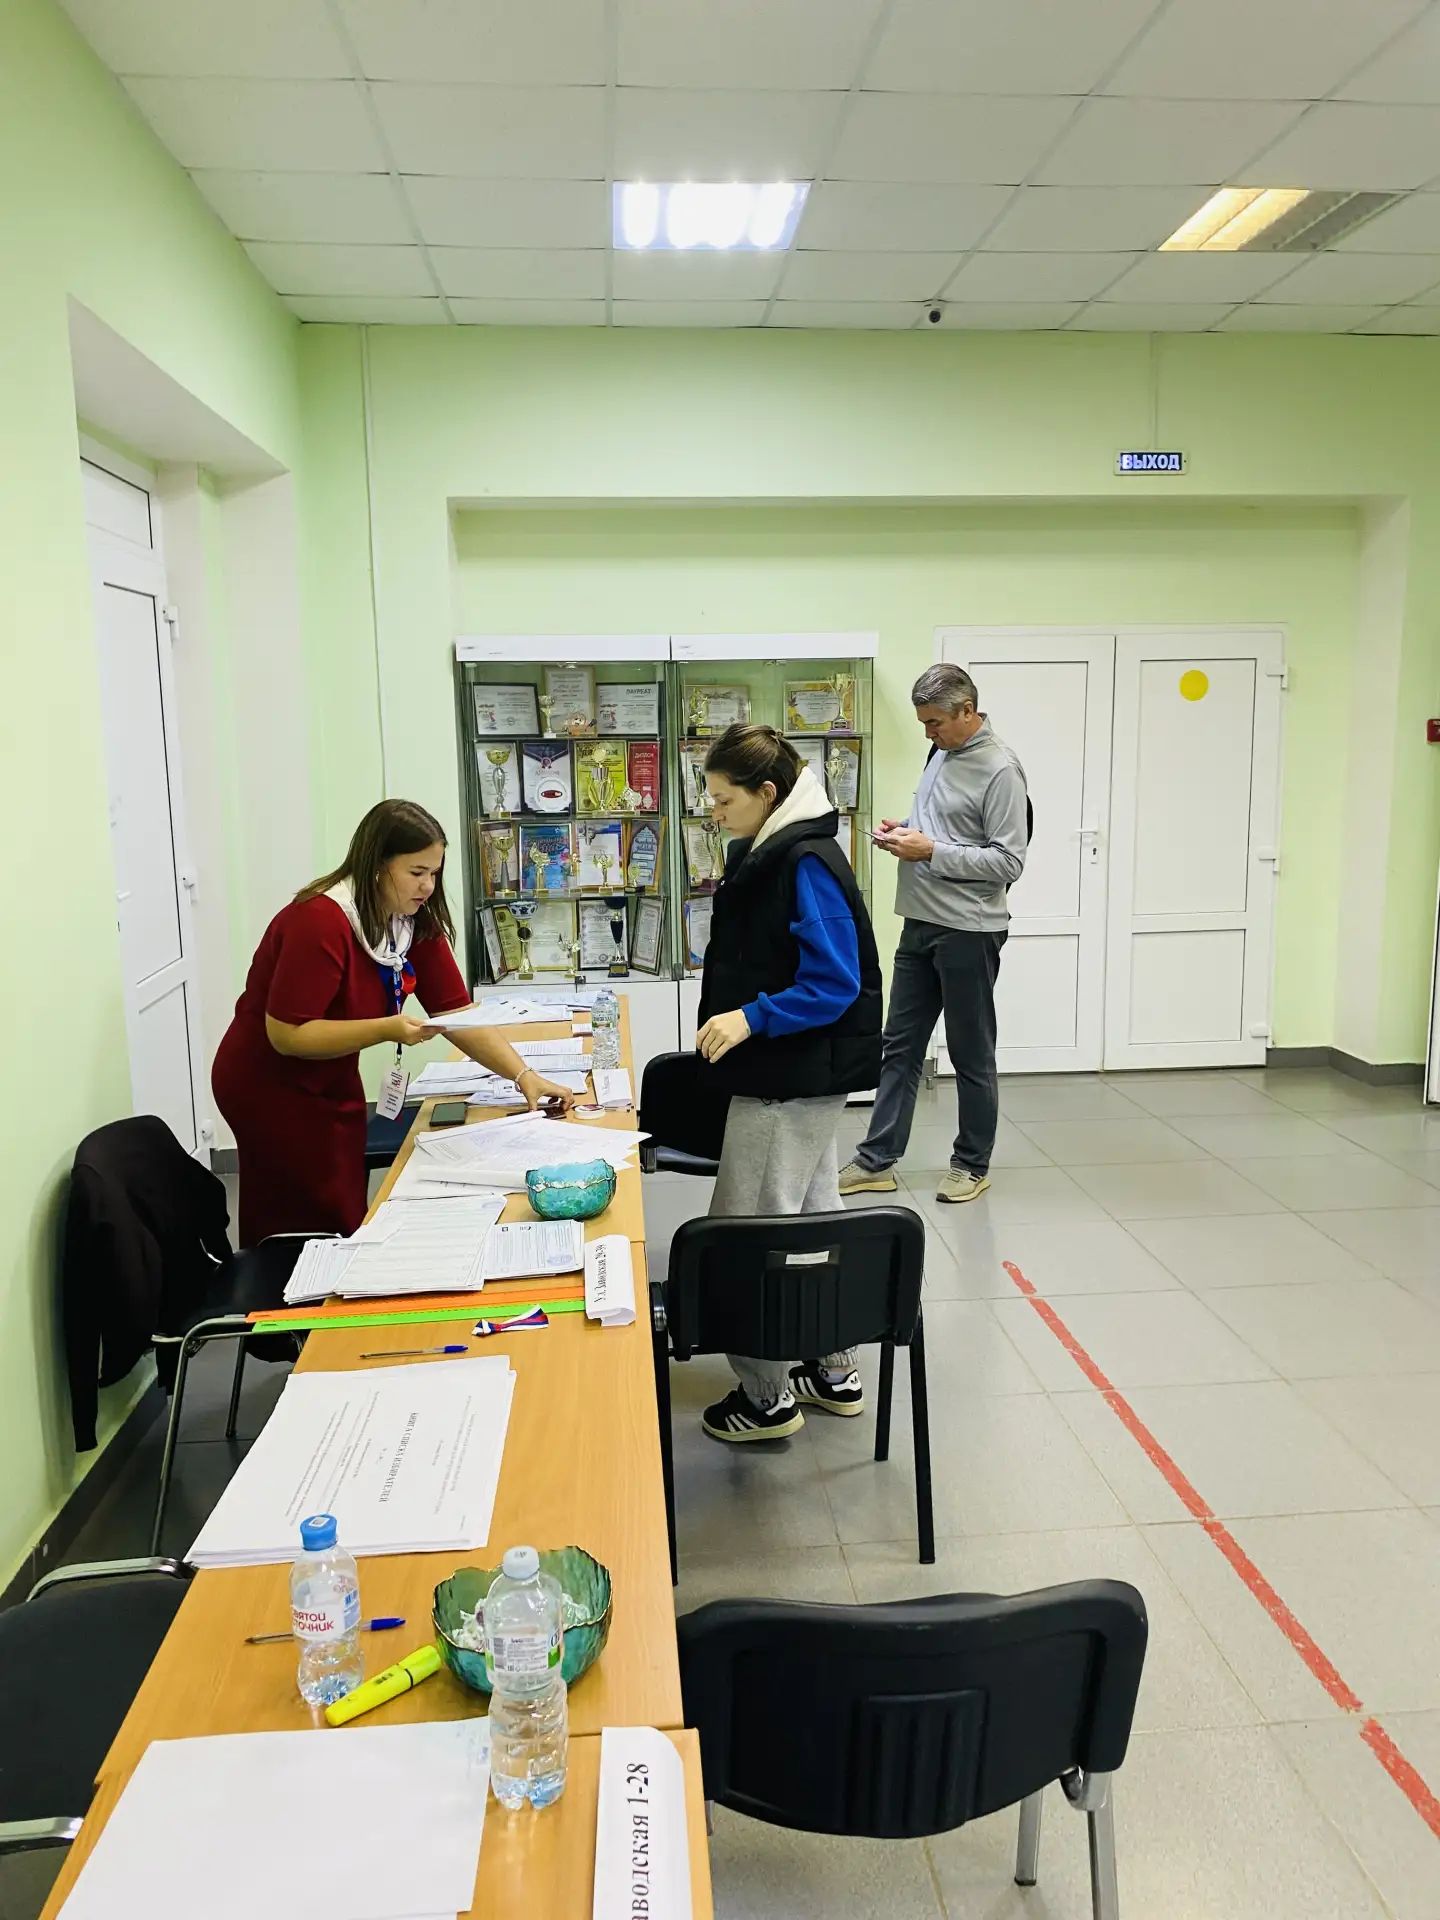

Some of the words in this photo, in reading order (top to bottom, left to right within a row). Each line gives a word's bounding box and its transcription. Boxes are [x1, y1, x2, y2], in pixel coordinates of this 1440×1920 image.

[1122, 454, 1180, 470] ВЫХОД
[405, 1412, 419, 1432] КНИГА
[395, 1432, 411, 1457] СПИСКА
[378, 1457, 403, 1502] ИЗБИРАТЕЛЕЙ
[626, 1763, 649, 1803] 1-28
